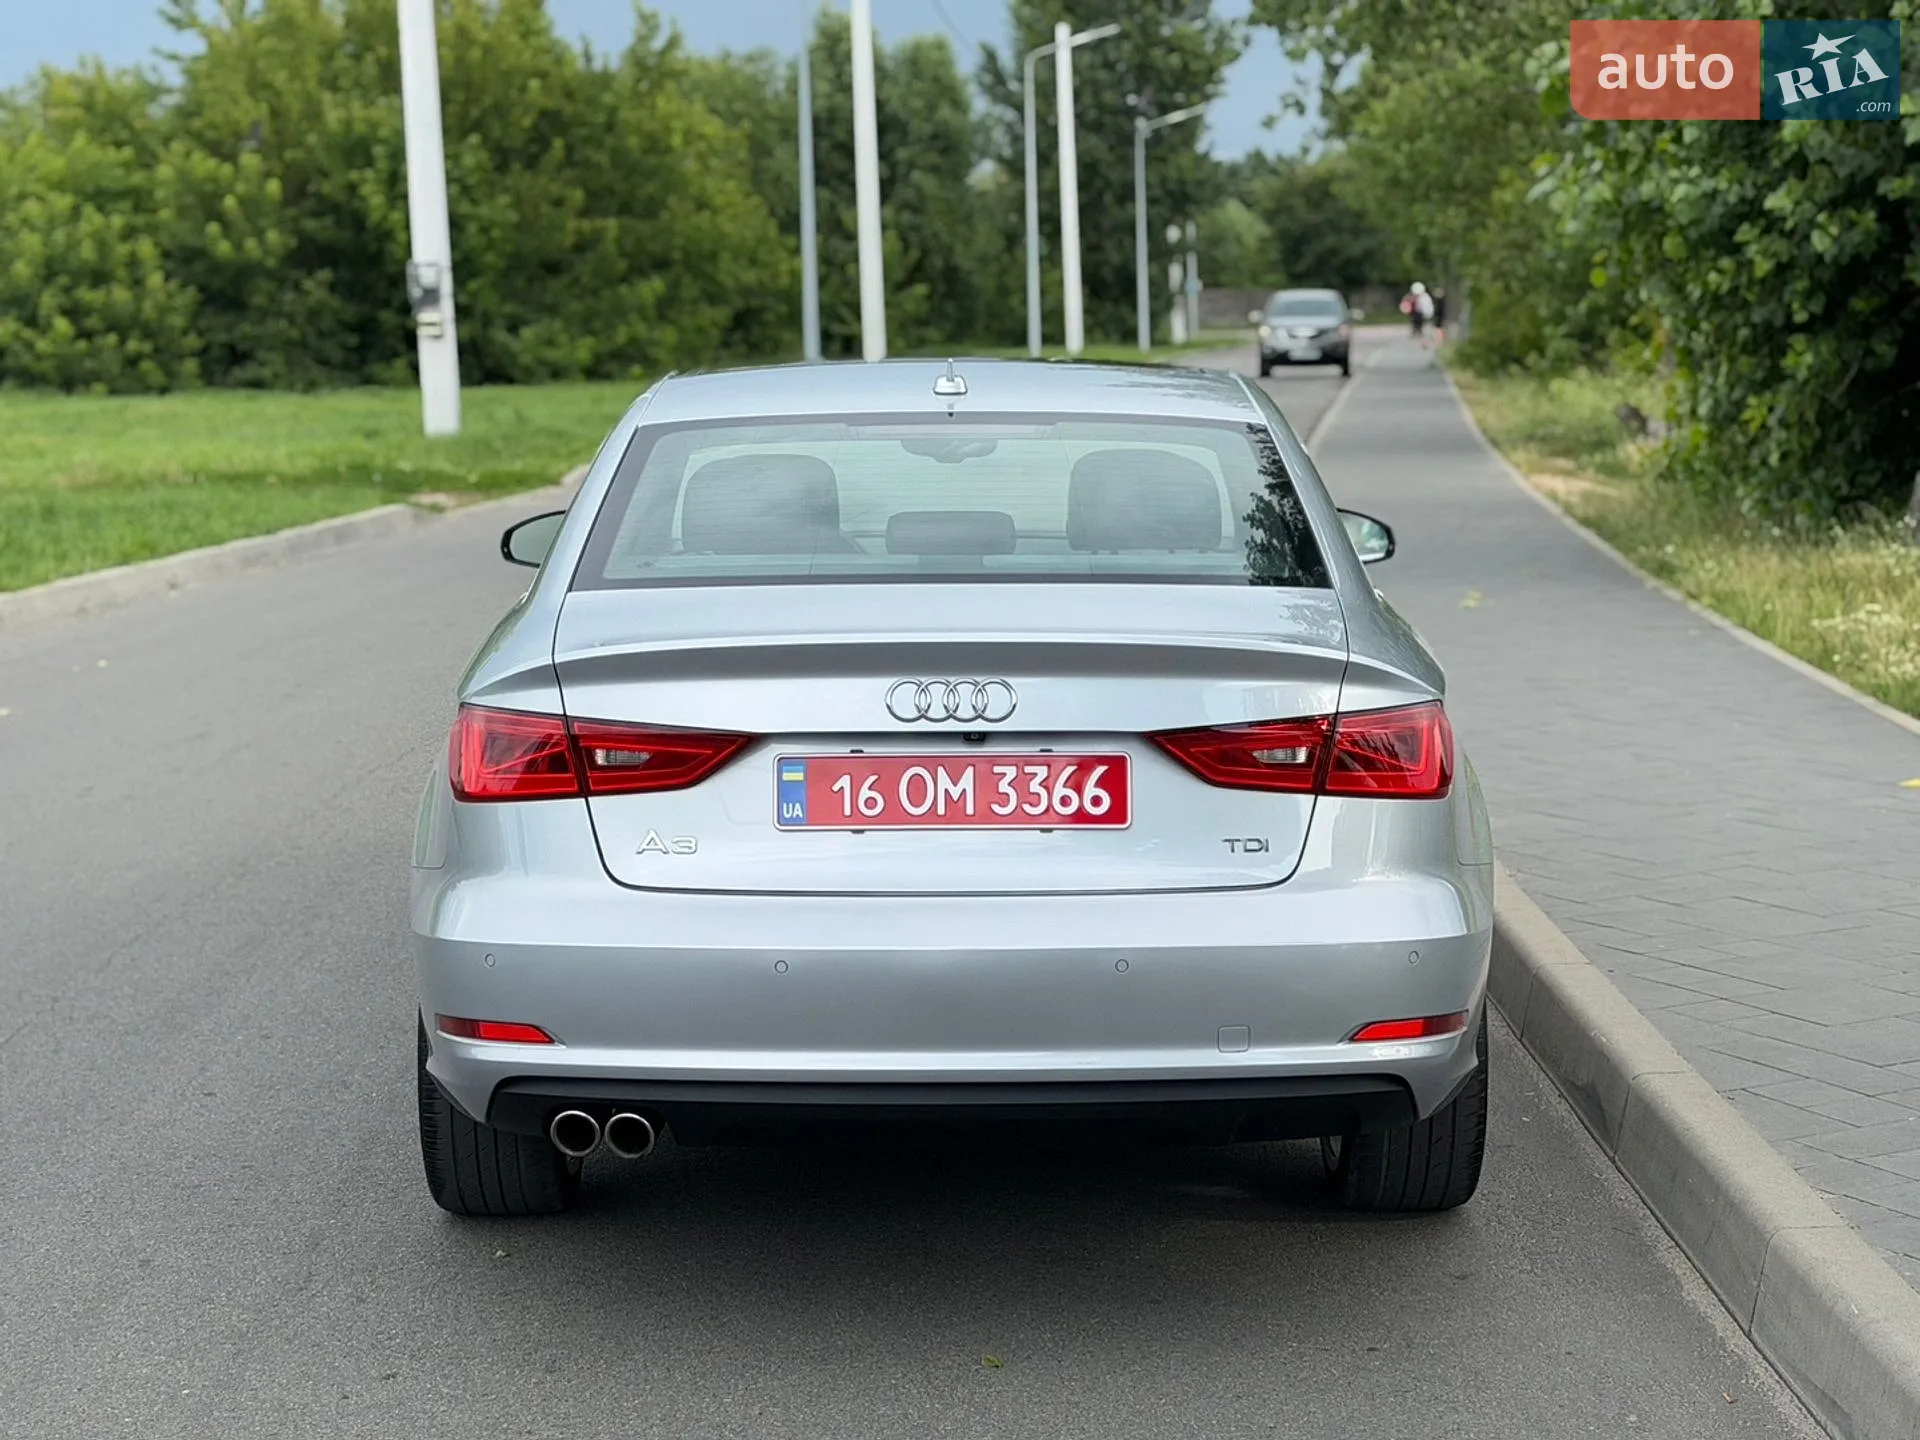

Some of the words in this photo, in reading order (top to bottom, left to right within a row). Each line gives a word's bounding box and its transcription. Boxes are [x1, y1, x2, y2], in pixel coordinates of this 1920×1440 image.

[831, 774, 886, 818] 16
[898, 765, 976, 817] OM
[990, 765, 1113, 816] 3366
[782, 804, 804, 820] UA
[636, 828, 698, 855] A3
[1222, 838, 1269, 853] TDI
